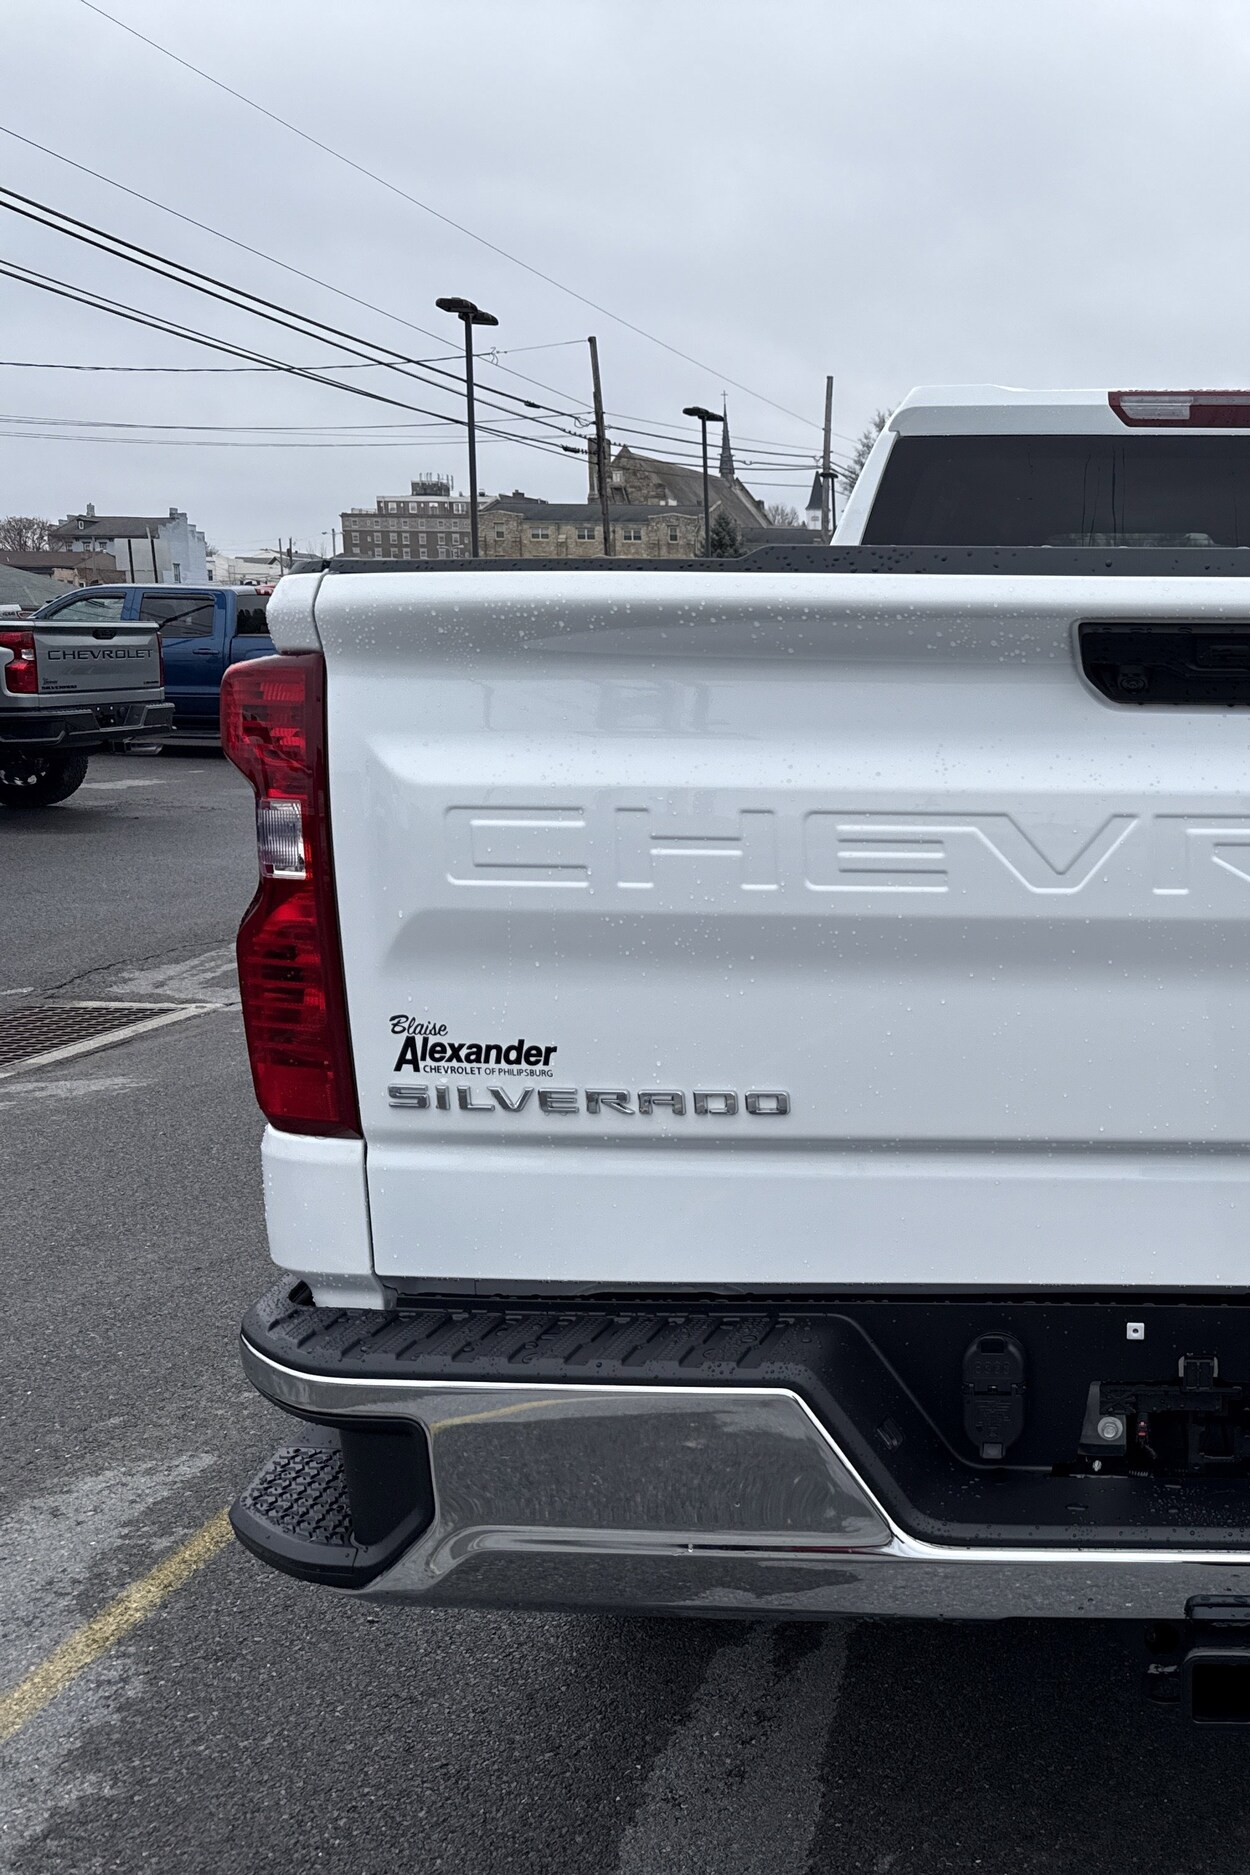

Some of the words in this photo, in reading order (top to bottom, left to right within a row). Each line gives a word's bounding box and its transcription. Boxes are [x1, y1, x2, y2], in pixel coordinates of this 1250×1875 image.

[48, 649, 153, 660] CHEVROLET
[389, 1014, 448, 1036] Blaise
[394, 1035, 558, 1073] Alexander
[423, 1065, 482, 1075] CHEVROLET
[484, 1067, 496, 1076] OF
[498, 1068, 554, 1077] PHILIPSBURG
[387, 1083, 791, 1117] SILVERADO
